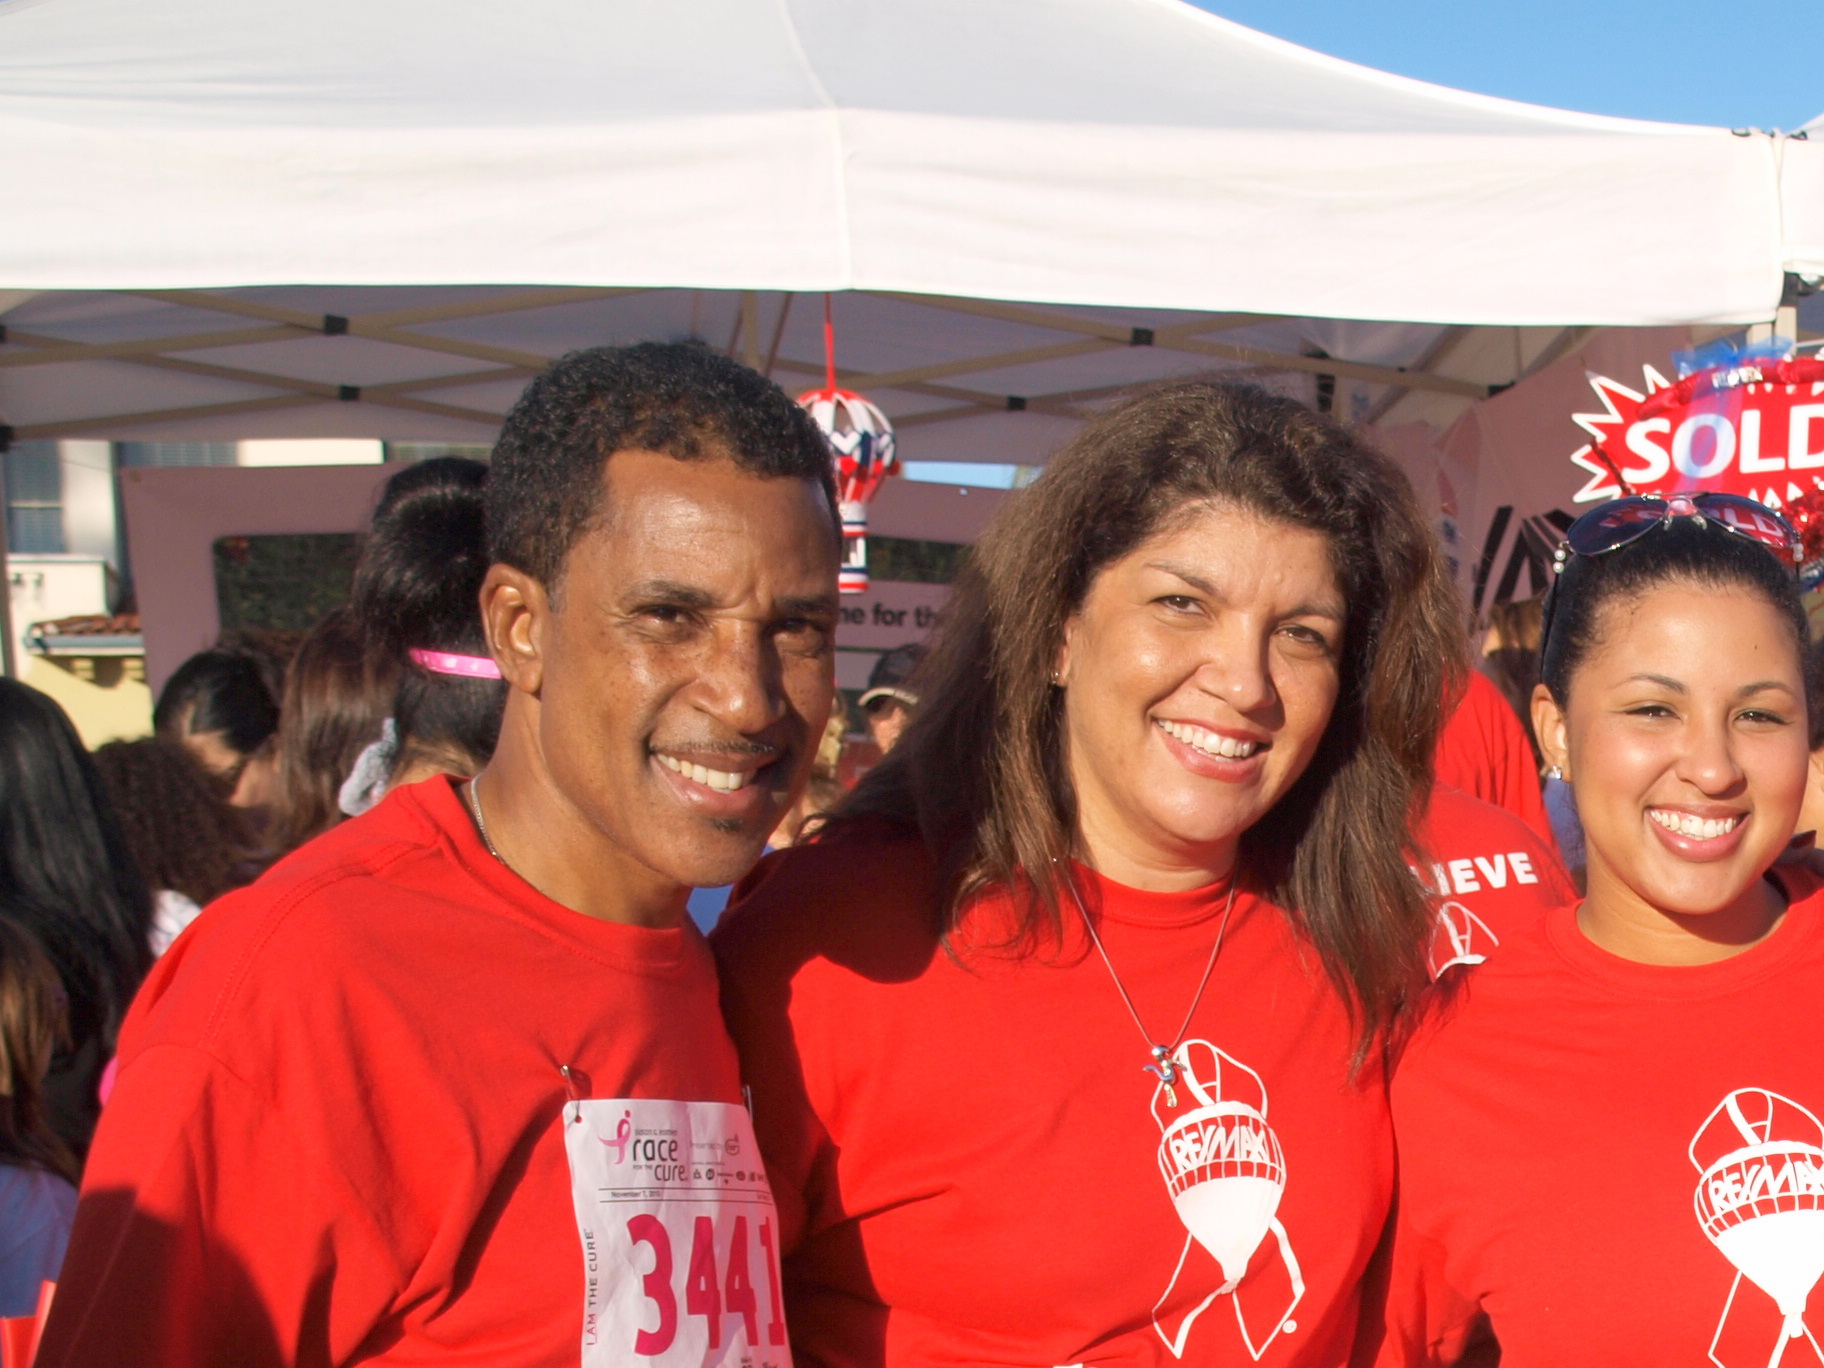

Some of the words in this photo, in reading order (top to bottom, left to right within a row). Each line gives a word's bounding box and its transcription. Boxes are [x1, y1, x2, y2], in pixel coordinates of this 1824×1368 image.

[872, 603, 907, 627] for
[633, 1138, 678, 1162] race
[1171, 1125, 1268, 1174] RE/MAX
[585, 1229, 598, 1273] CURE
[588, 1278, 598, 1308] THE
[626, 1214, 785, 1356] 3441
[587, 1314, 597, 1335] AM
